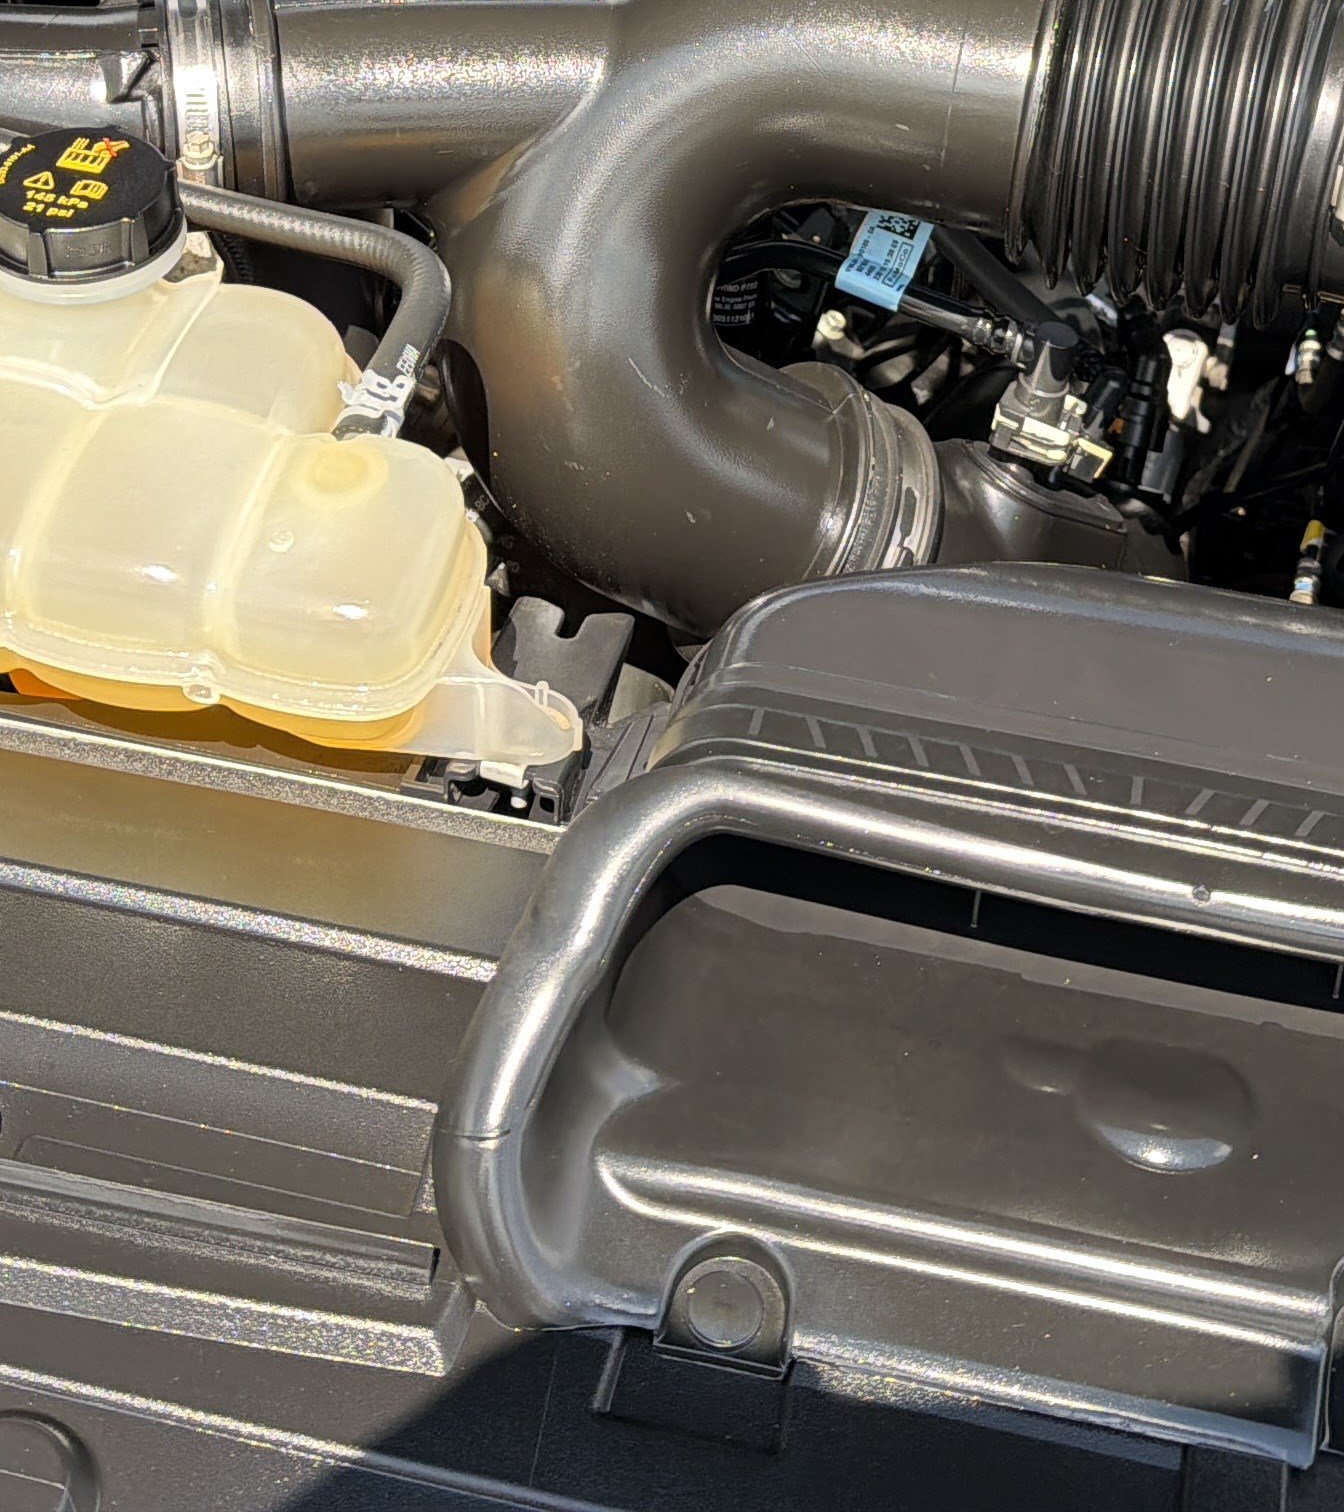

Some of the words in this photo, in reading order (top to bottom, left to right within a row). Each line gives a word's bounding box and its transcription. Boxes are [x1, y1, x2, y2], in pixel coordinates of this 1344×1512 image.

[26, 190, 56, 202] 145
[57, 195, 89, 209] kPa
[23, 201, 45, 212] 21
[45, 207, 75, 218] psi
